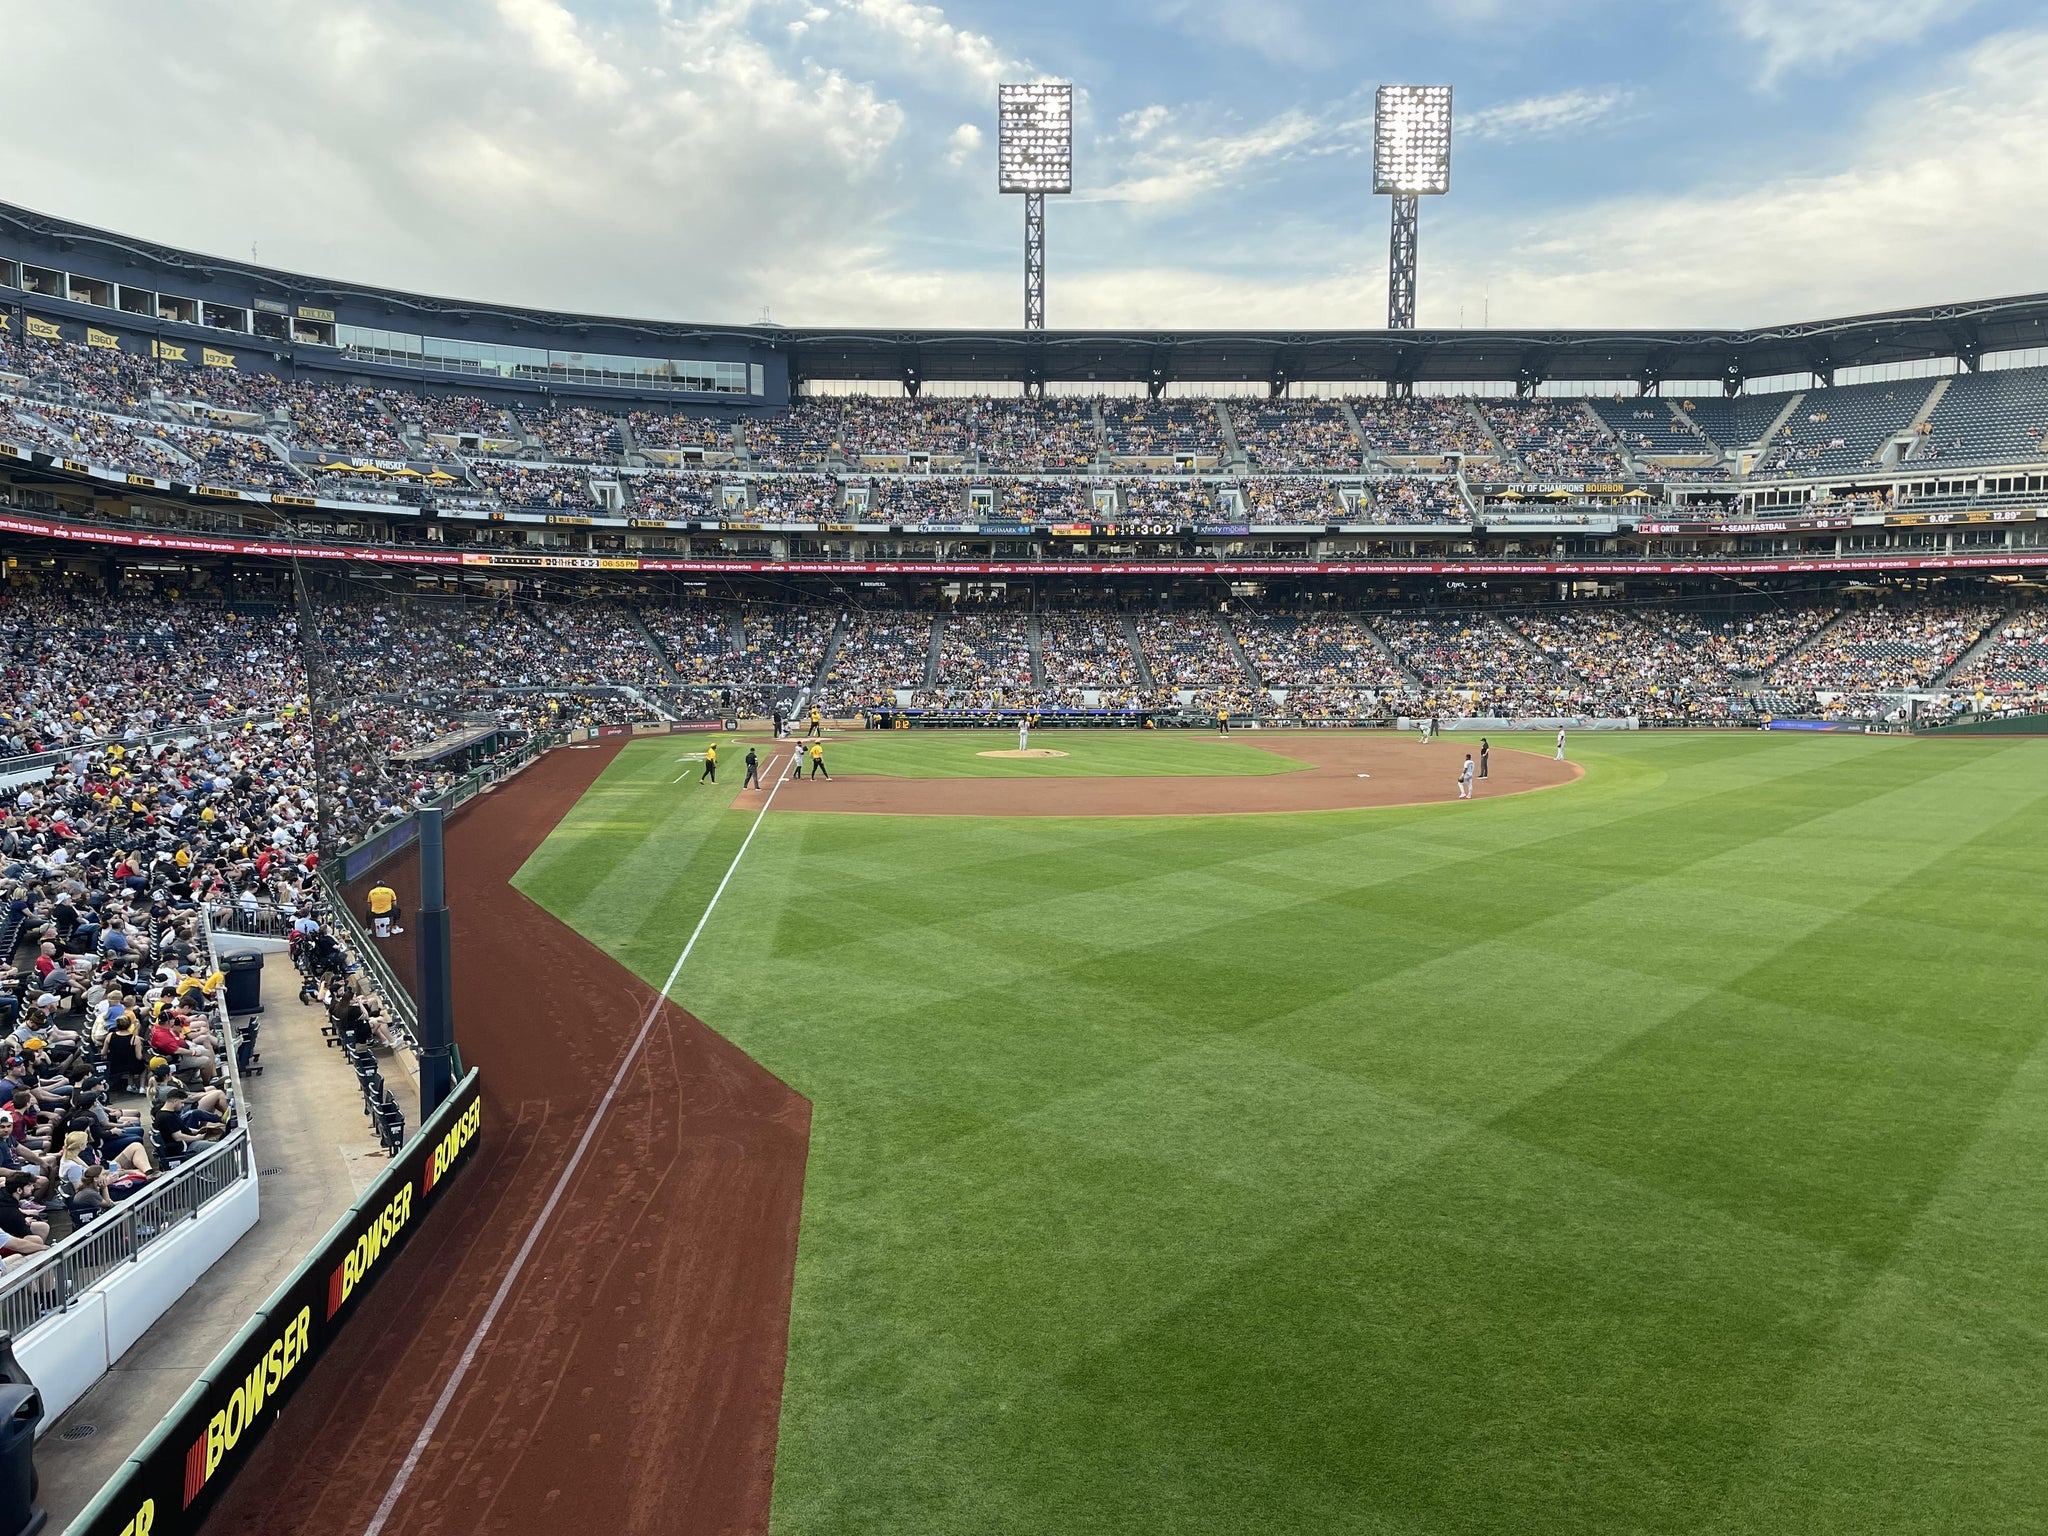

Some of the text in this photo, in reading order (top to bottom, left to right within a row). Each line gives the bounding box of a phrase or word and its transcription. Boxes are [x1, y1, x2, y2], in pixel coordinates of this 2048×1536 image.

[30, 322, 53, 335] 1925
[90, 333, 112, 346] 1960
[205, 353, 228, 364] 1979
[351, 457, 406, 470] WIGLE WHISKEY
[1508, 484, 1623, 493] CITY OF CHAMPIONS BOURBON
[919, 525, 928, 533] 42
[1141, 524, 1149, 535] 3
[1153, 524, 1161, 535] 0
[1166, 524, 1174, 535] 2
[1200, 524, 1223, 534] xfinity
[1721, 524, 1750, 532] 4-SEAM
[1751, 522, 1786, 531] FASTBALL
[626, 560, 638, 568] PM
[2020, 557, 2048, 565] grocerie
[432, 1095, 480, 1184] BOWSER
[341, 1181, 412, 1303] BOWSER
[205, 1305, 310, 1483] BOWSER
